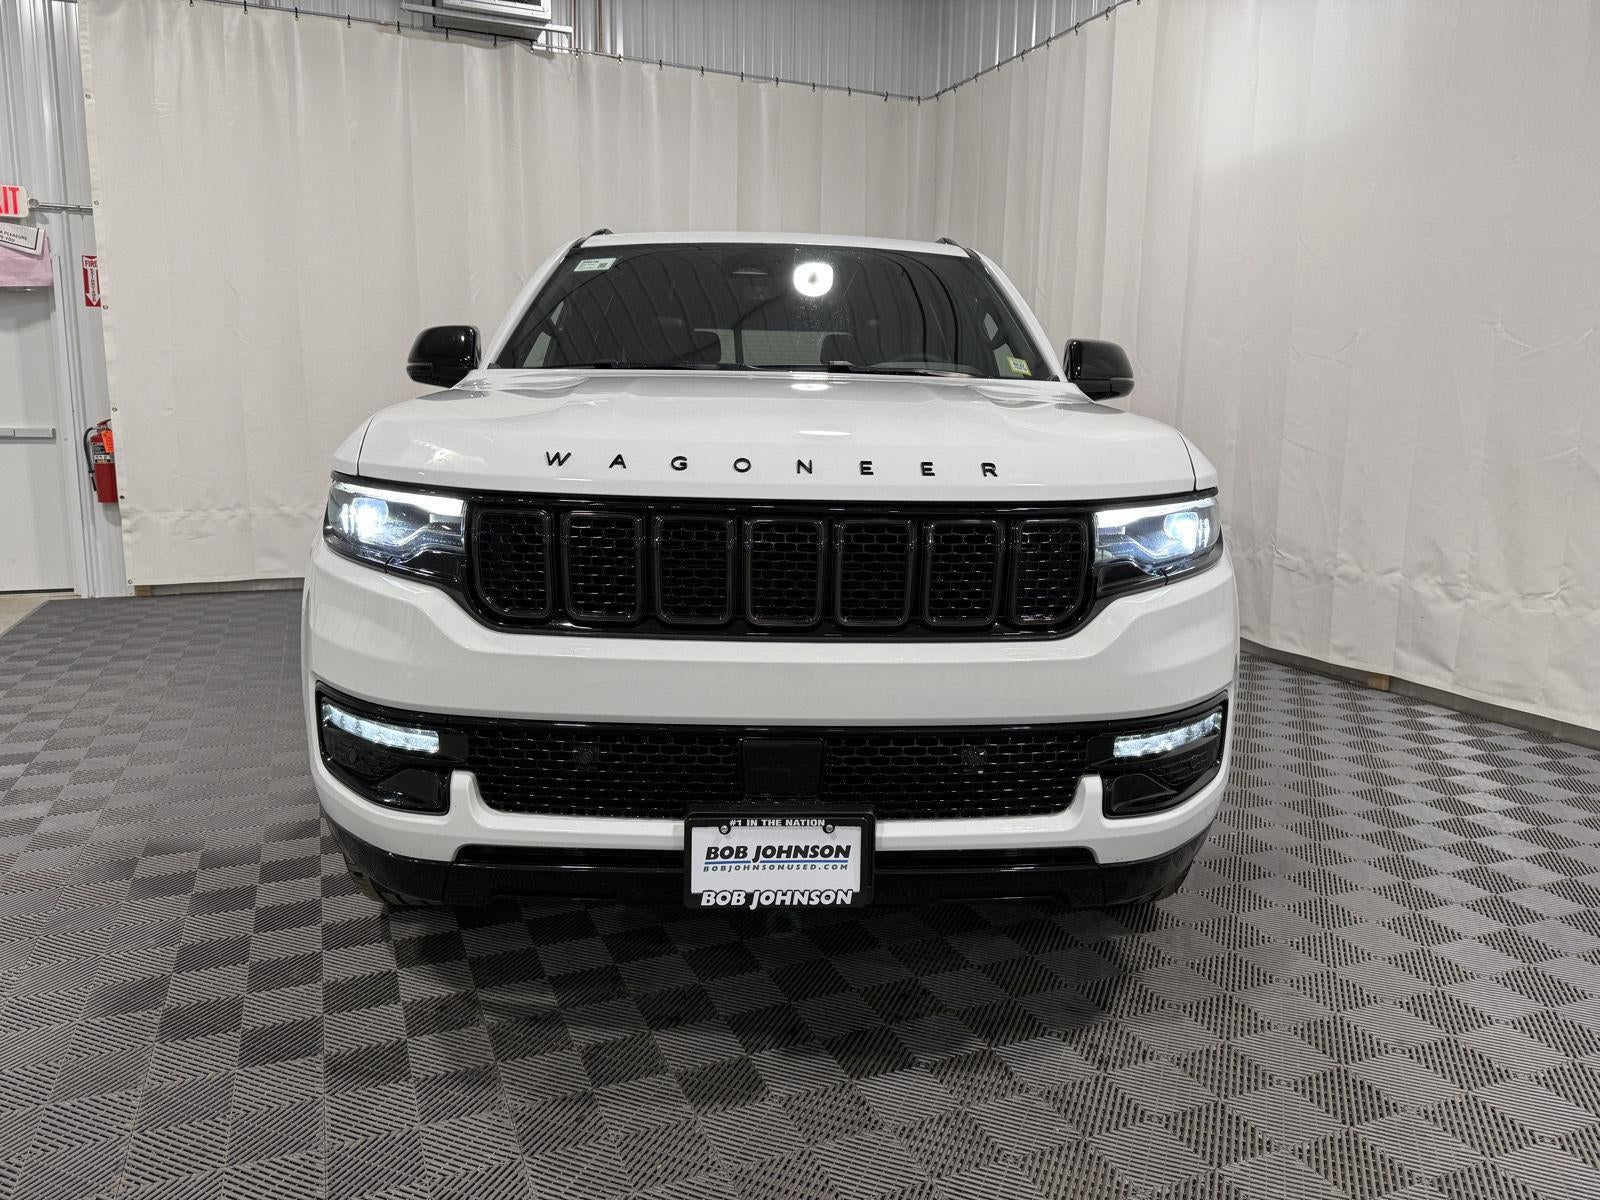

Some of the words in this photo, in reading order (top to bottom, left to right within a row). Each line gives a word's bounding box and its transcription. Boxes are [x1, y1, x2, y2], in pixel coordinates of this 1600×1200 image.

[84, 260, 98, 268] FIRE
[545, 450, 999, 478] WAGONEER
[729, 819, 742, 827] #1
[746, 819, 757, 827] IN
[761, 819, 782, 827] THE
[785, 819, 826, 827] NATION
[705, 846, 748, 860] BOB
[752, 845, 851, 863] JOHNSON
[703, 863, 849, 872] BOBJOHNSONUSED.COM
[700, 890, 746, 906] BOB
[750, 889, 853, 910] JOHNSON
